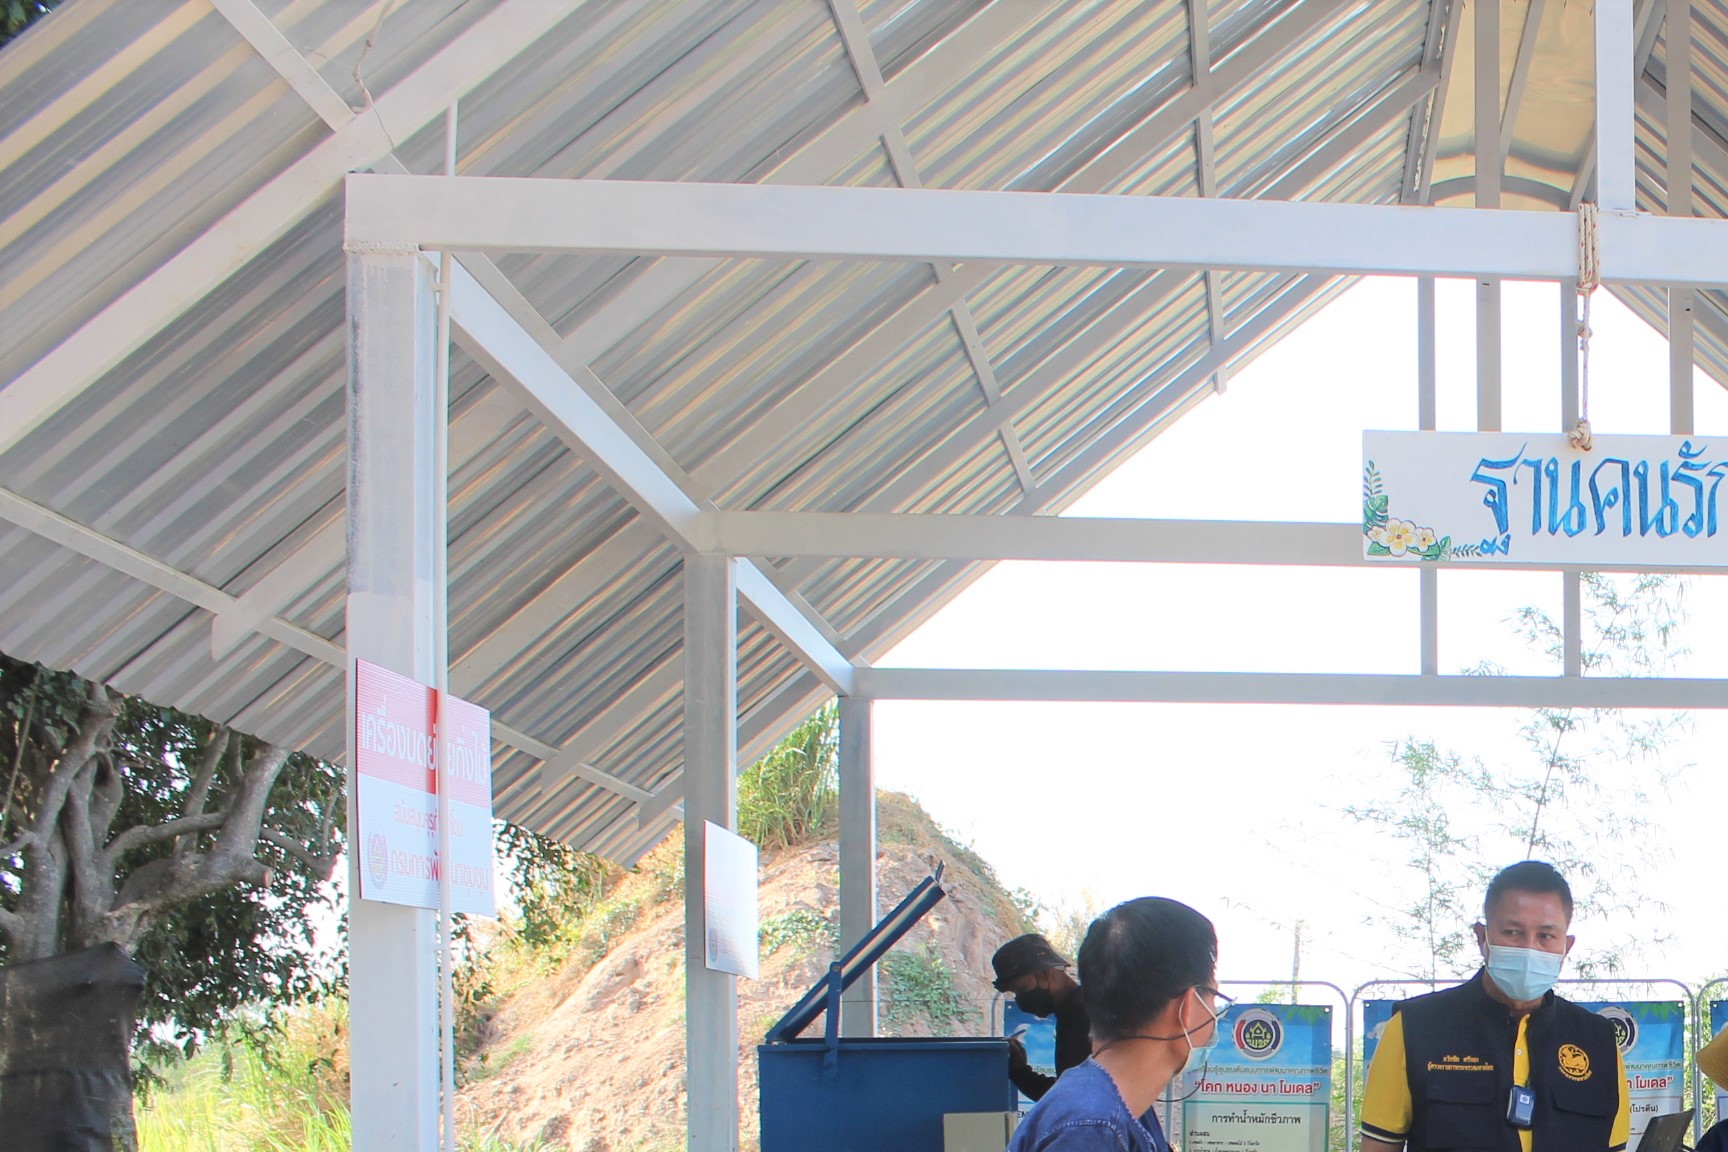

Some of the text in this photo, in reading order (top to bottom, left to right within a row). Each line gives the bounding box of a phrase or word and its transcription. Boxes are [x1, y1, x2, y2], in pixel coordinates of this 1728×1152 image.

[361, 694, 487, 785] เครื่องบดย่ยกิ่งไม้
[391, 848, 489, 894] กรมการพันาชุมชน
[1226, 1082, 1257, 1094] หนอง
[1261, 1083, 1276, 1094] นา
[1211, 1109, 1301, 1124] การทำน้ำหมักชีวภาพ
